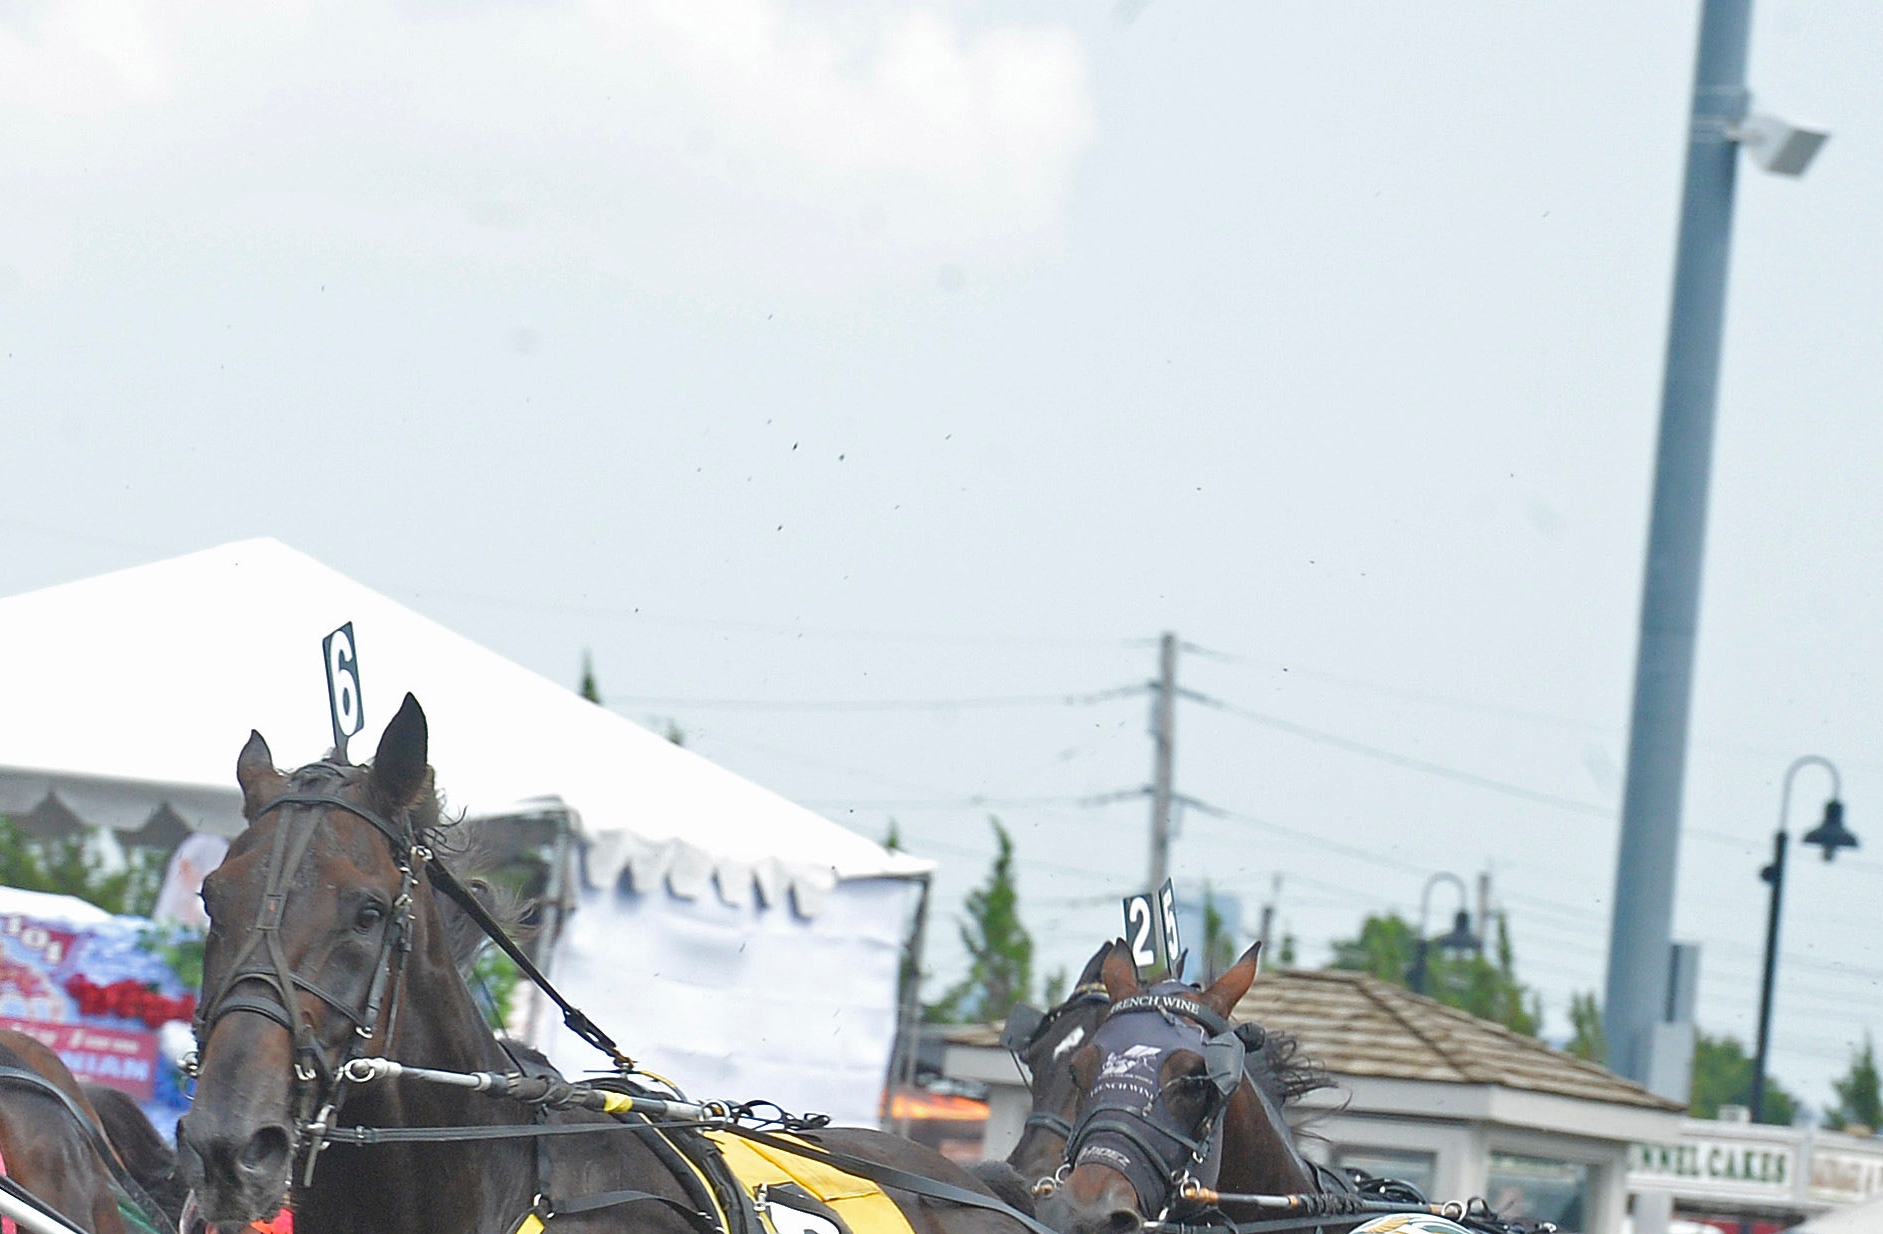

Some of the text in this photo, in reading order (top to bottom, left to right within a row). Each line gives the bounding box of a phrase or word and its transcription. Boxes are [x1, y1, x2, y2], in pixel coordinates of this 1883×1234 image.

[329, 629, 359, 737] 6
[1129, 896, 1155, 967] 2
[1162, 888, 1179, 961] 5
[1110, 995, 1200, 1015] FRENCH WINE
[1708, 1148, 1787, 1184] CAKES
